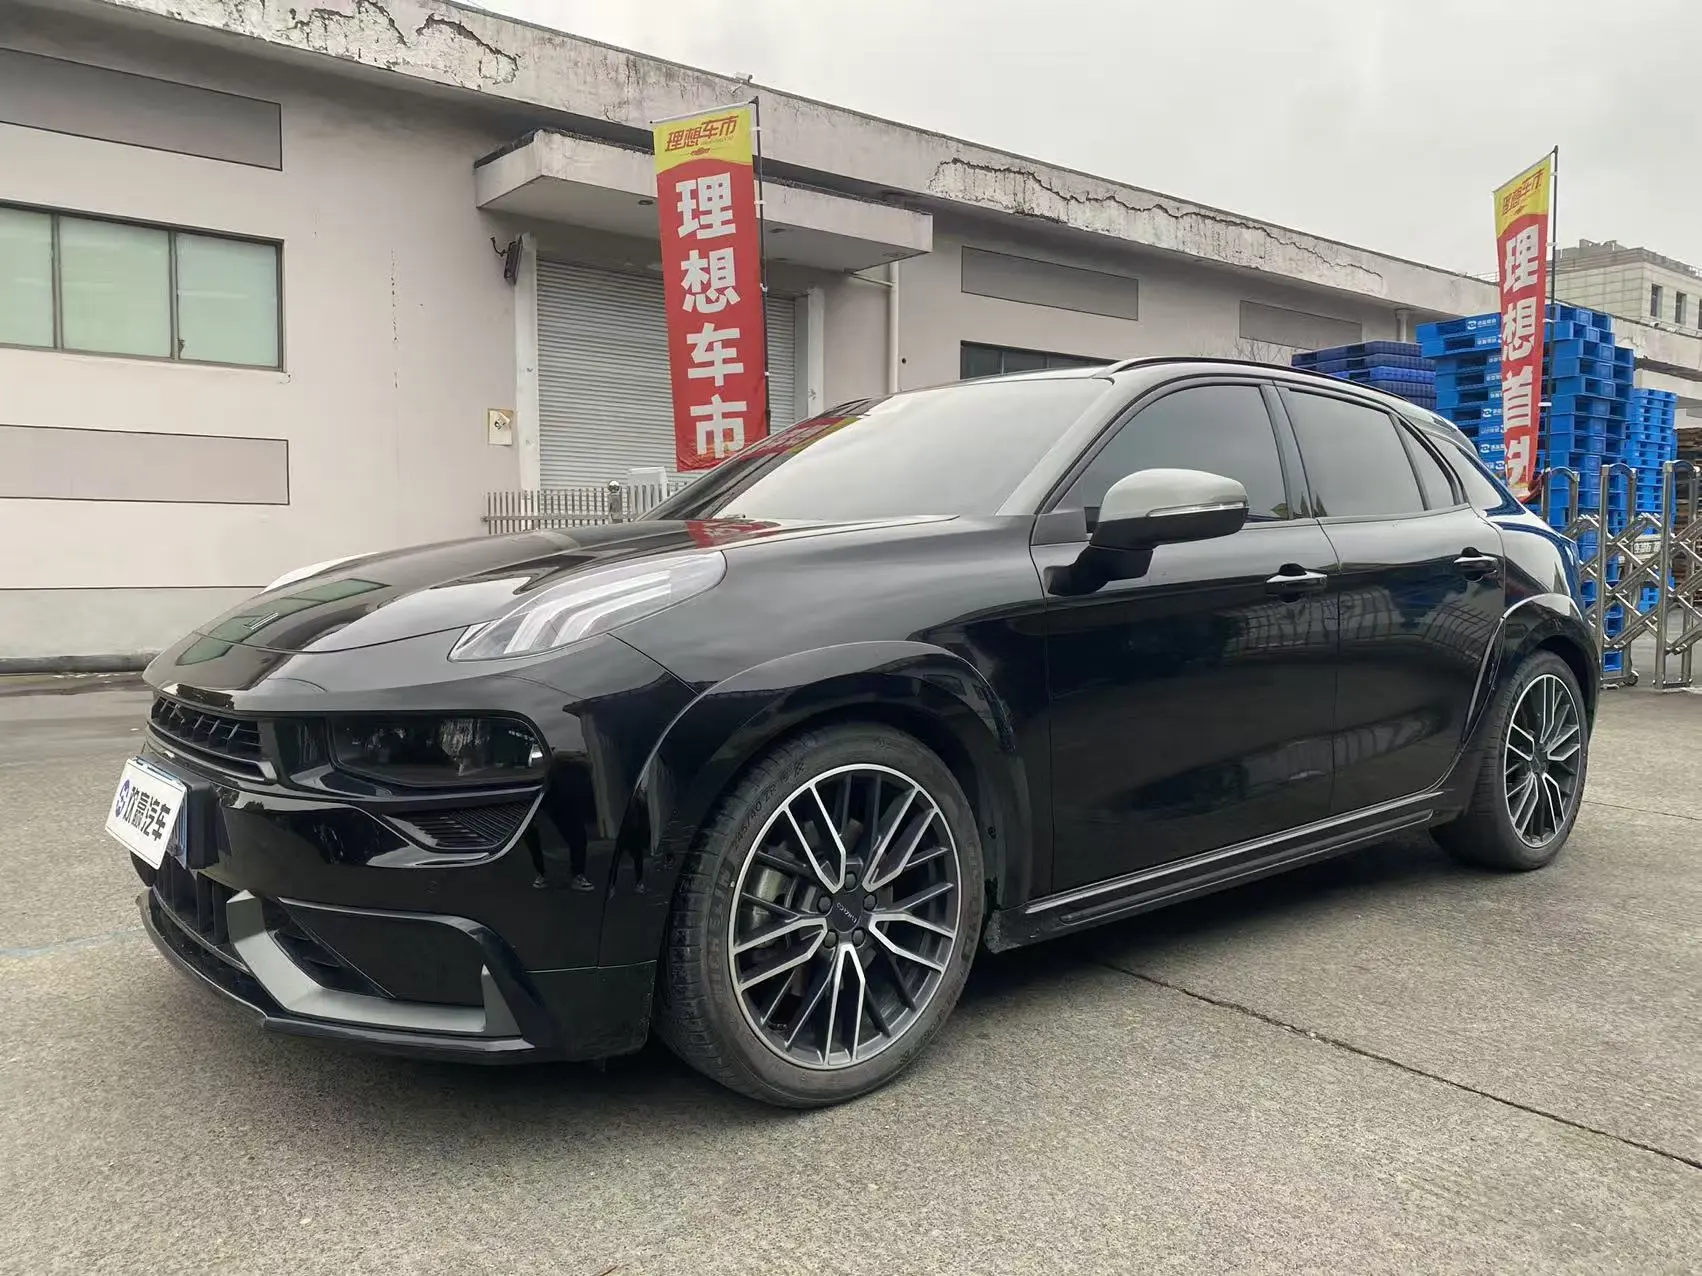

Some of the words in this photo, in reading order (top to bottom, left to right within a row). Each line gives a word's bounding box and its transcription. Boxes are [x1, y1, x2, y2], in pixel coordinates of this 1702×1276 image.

[665, 115, 739, 152] 理想车市
[675, 172, 747, 459] 理想车市
